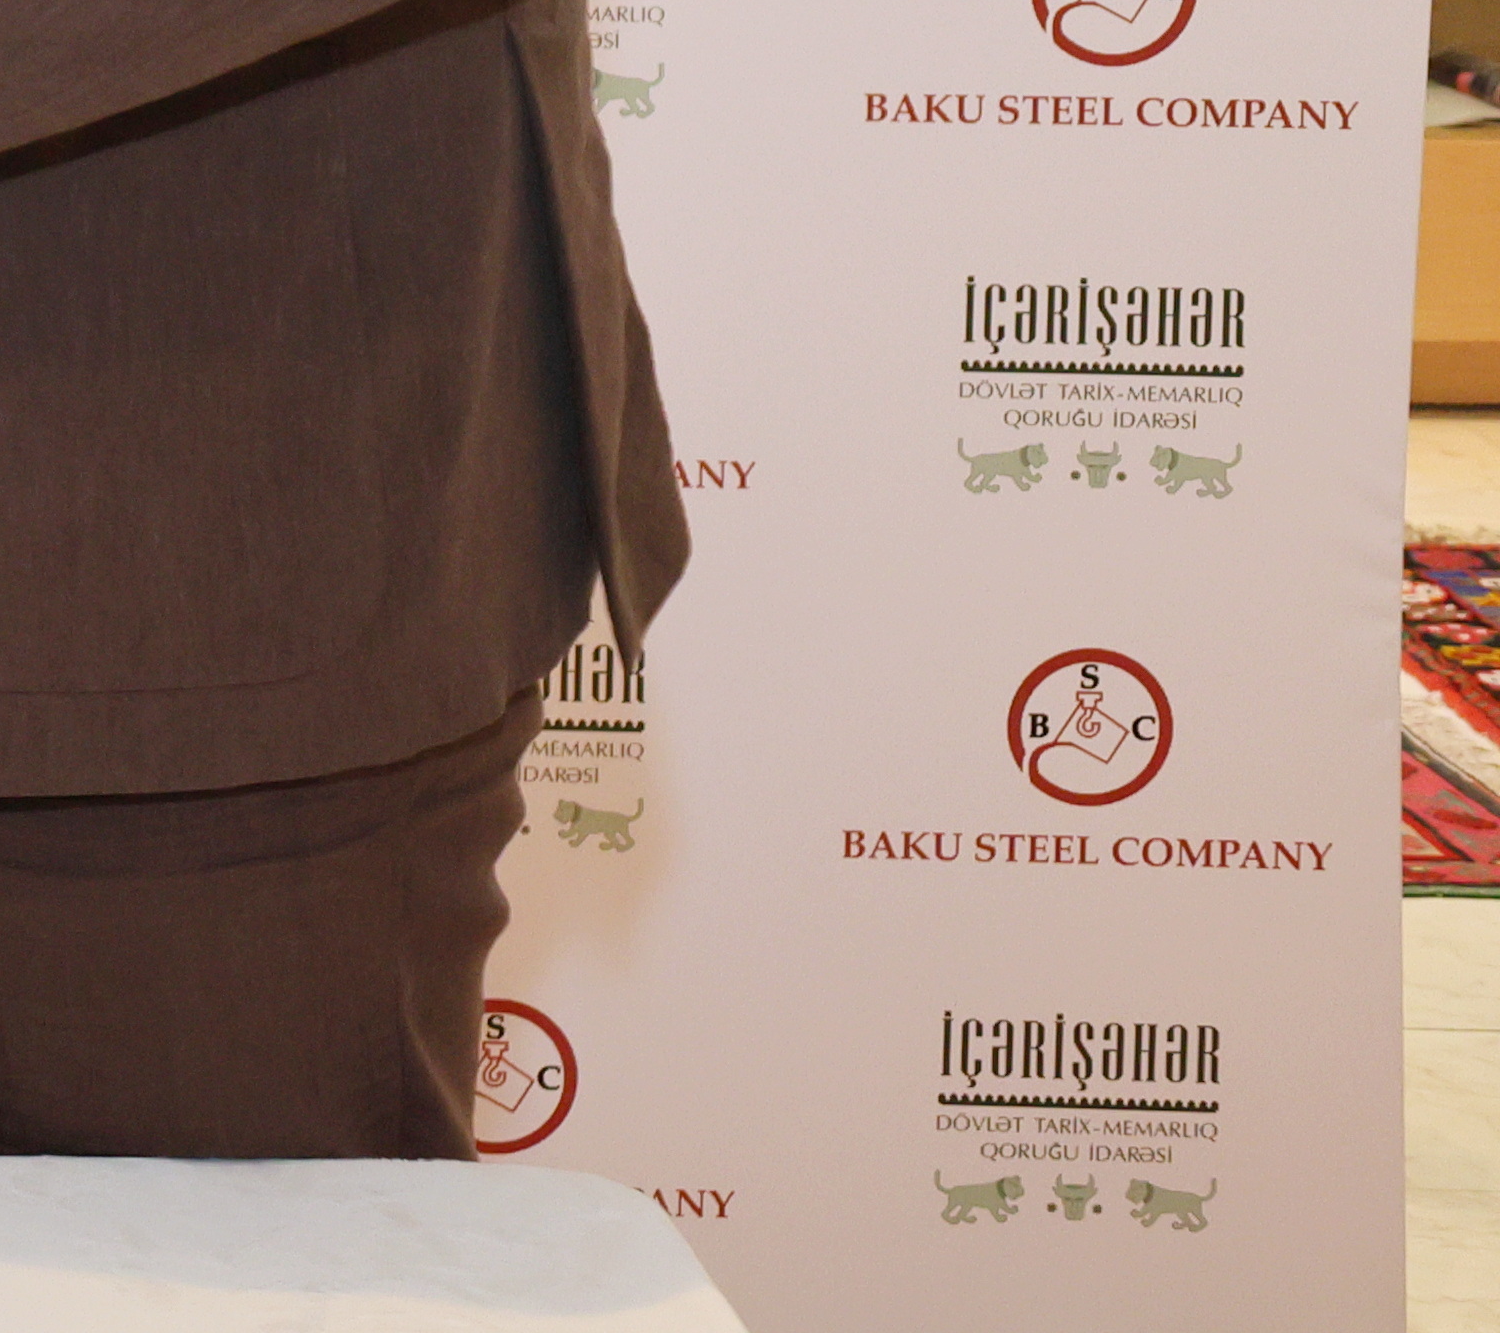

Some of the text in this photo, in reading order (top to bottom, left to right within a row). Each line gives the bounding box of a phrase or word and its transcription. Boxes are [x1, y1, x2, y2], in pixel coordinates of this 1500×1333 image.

[865, 93, 1359, 131] BAKU STEEL COMPANY
[958, 379, 1048, 400] DÖVLƏT
[1003, 408, 1103, 430] QORUĞU
[1081, 665, 1099, 689] S
[1030, 714, 1155, 741] B C
[842, 829, 1333, 871] BAKU STEEL COMPANY
[935, 1112, 1024, 1134] DÖVLƏT
[979, 1142, 1080, 1163] QORUĞU
